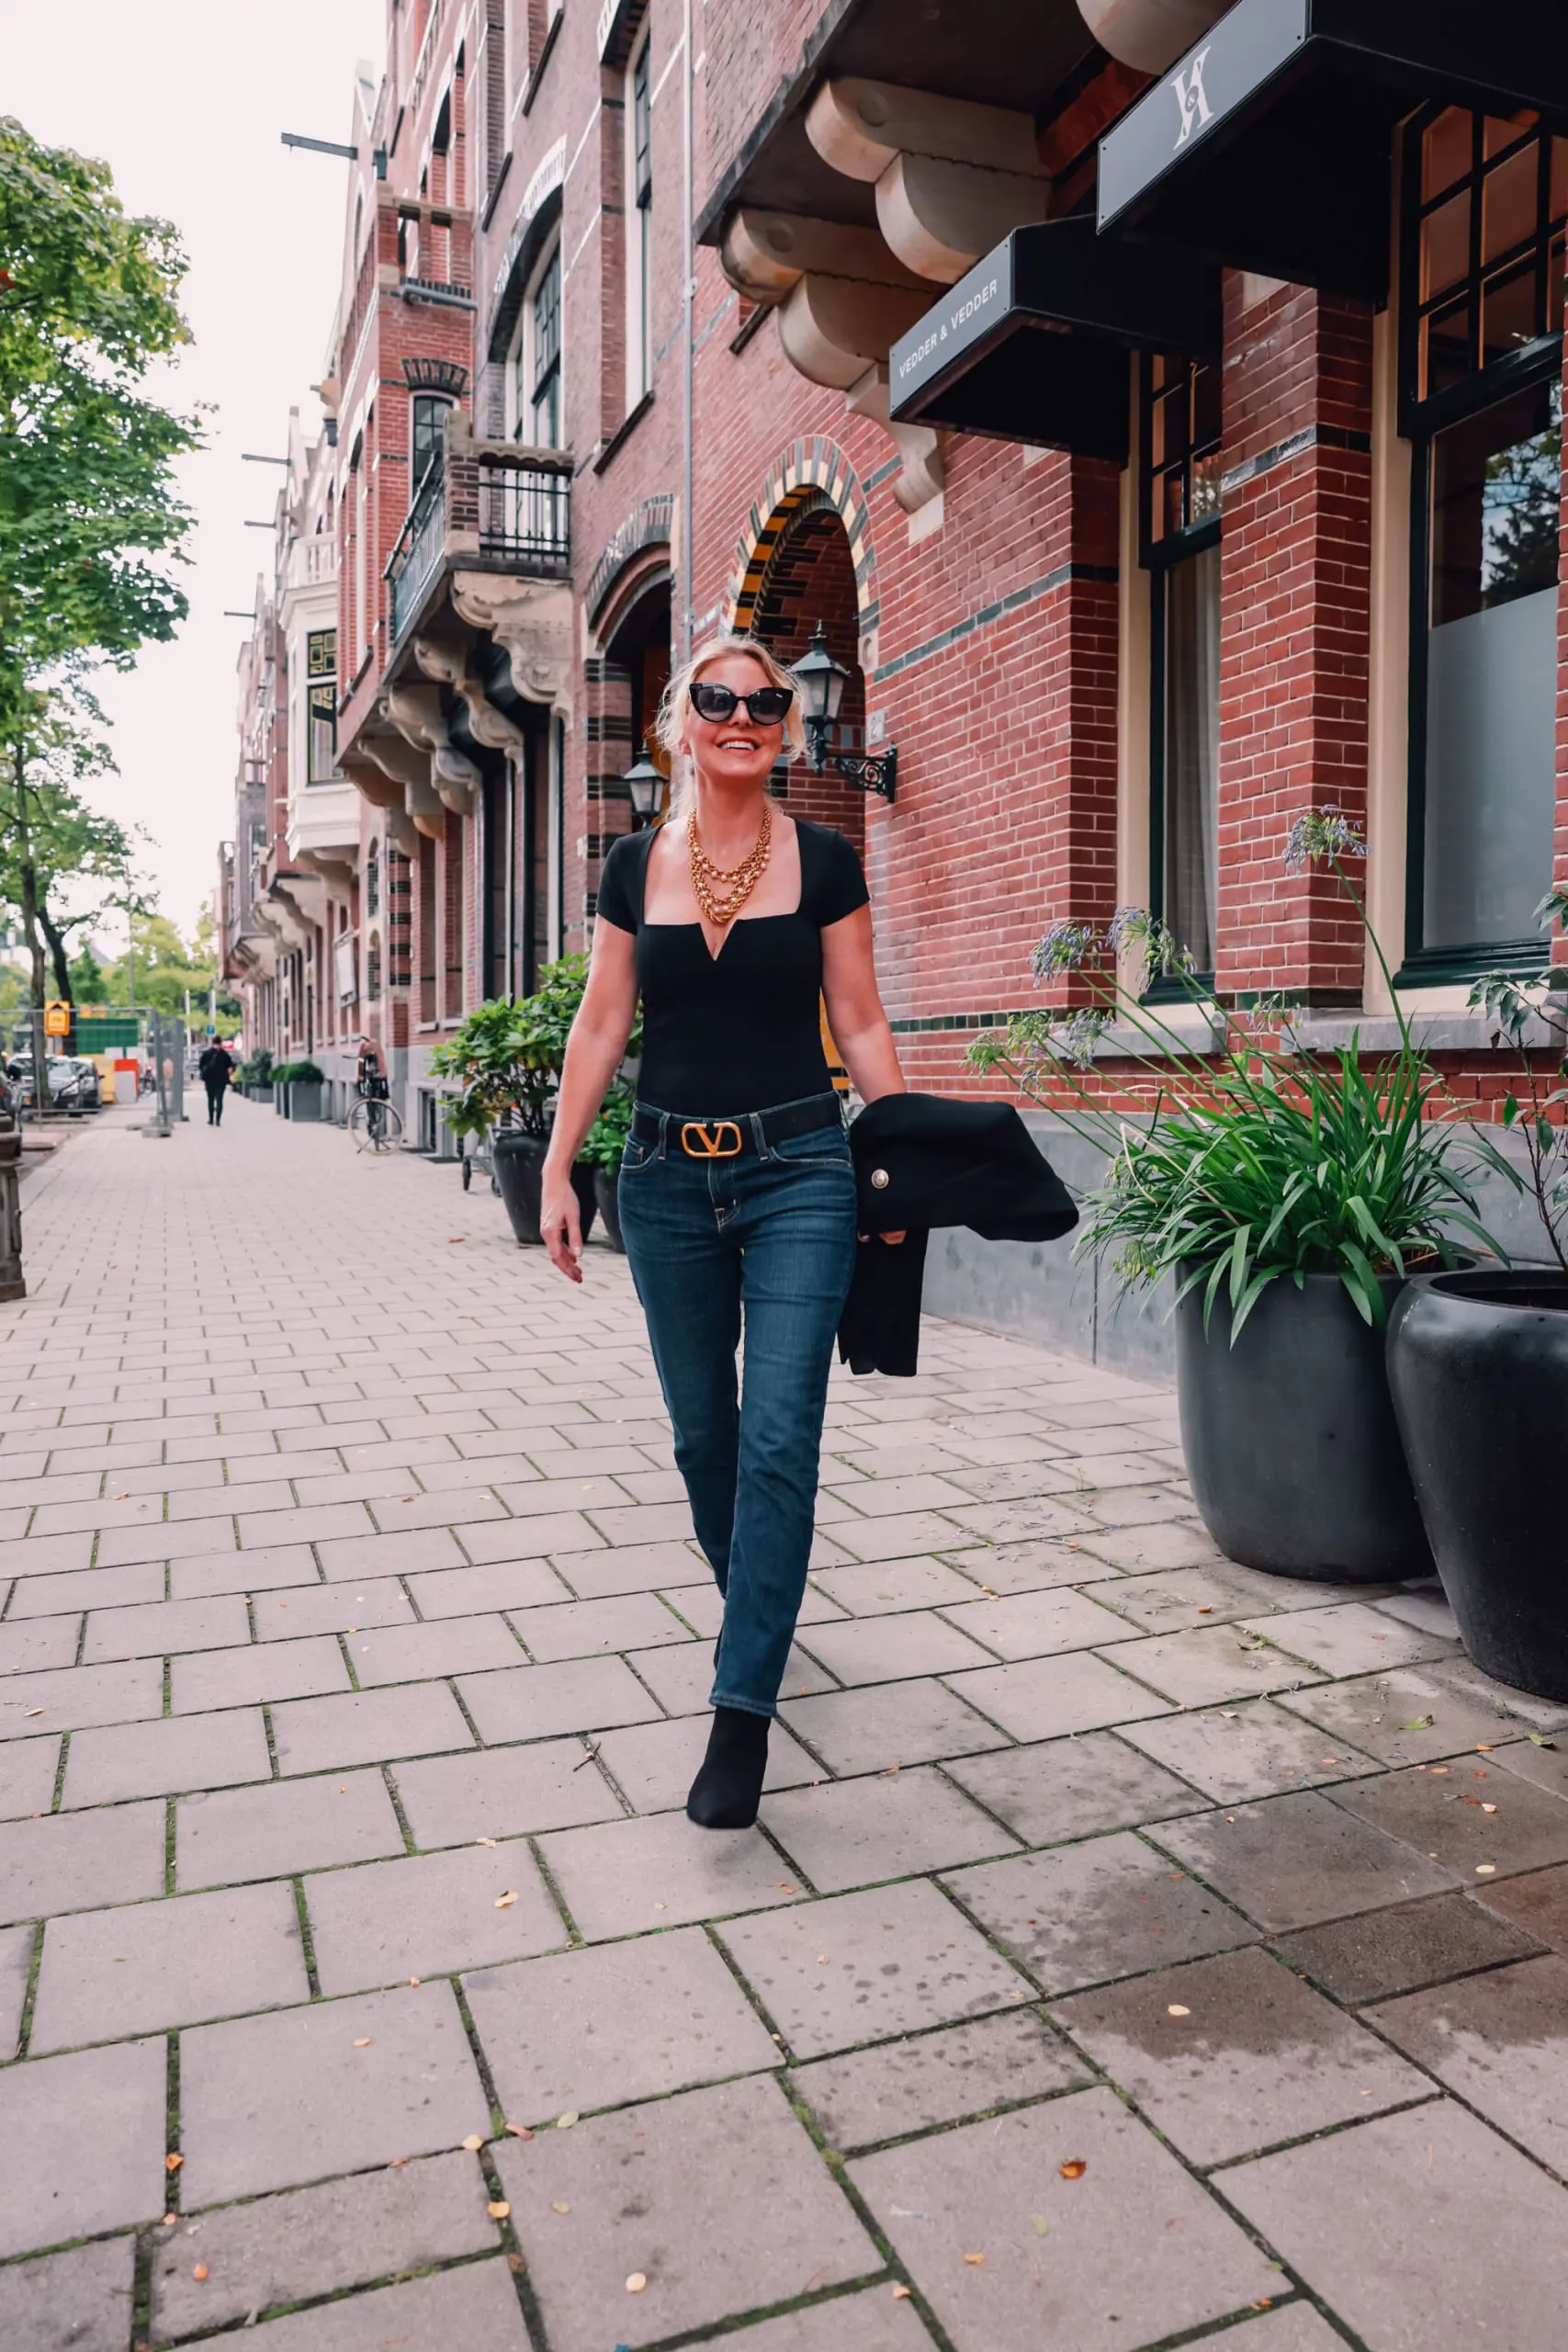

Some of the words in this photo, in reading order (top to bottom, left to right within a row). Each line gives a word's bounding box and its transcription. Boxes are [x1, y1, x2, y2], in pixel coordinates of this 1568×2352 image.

[899, 333, 937, 379] VEDDER
[940, 324, 948, 340] &
[951, 278, 998, 330] VEDDER
